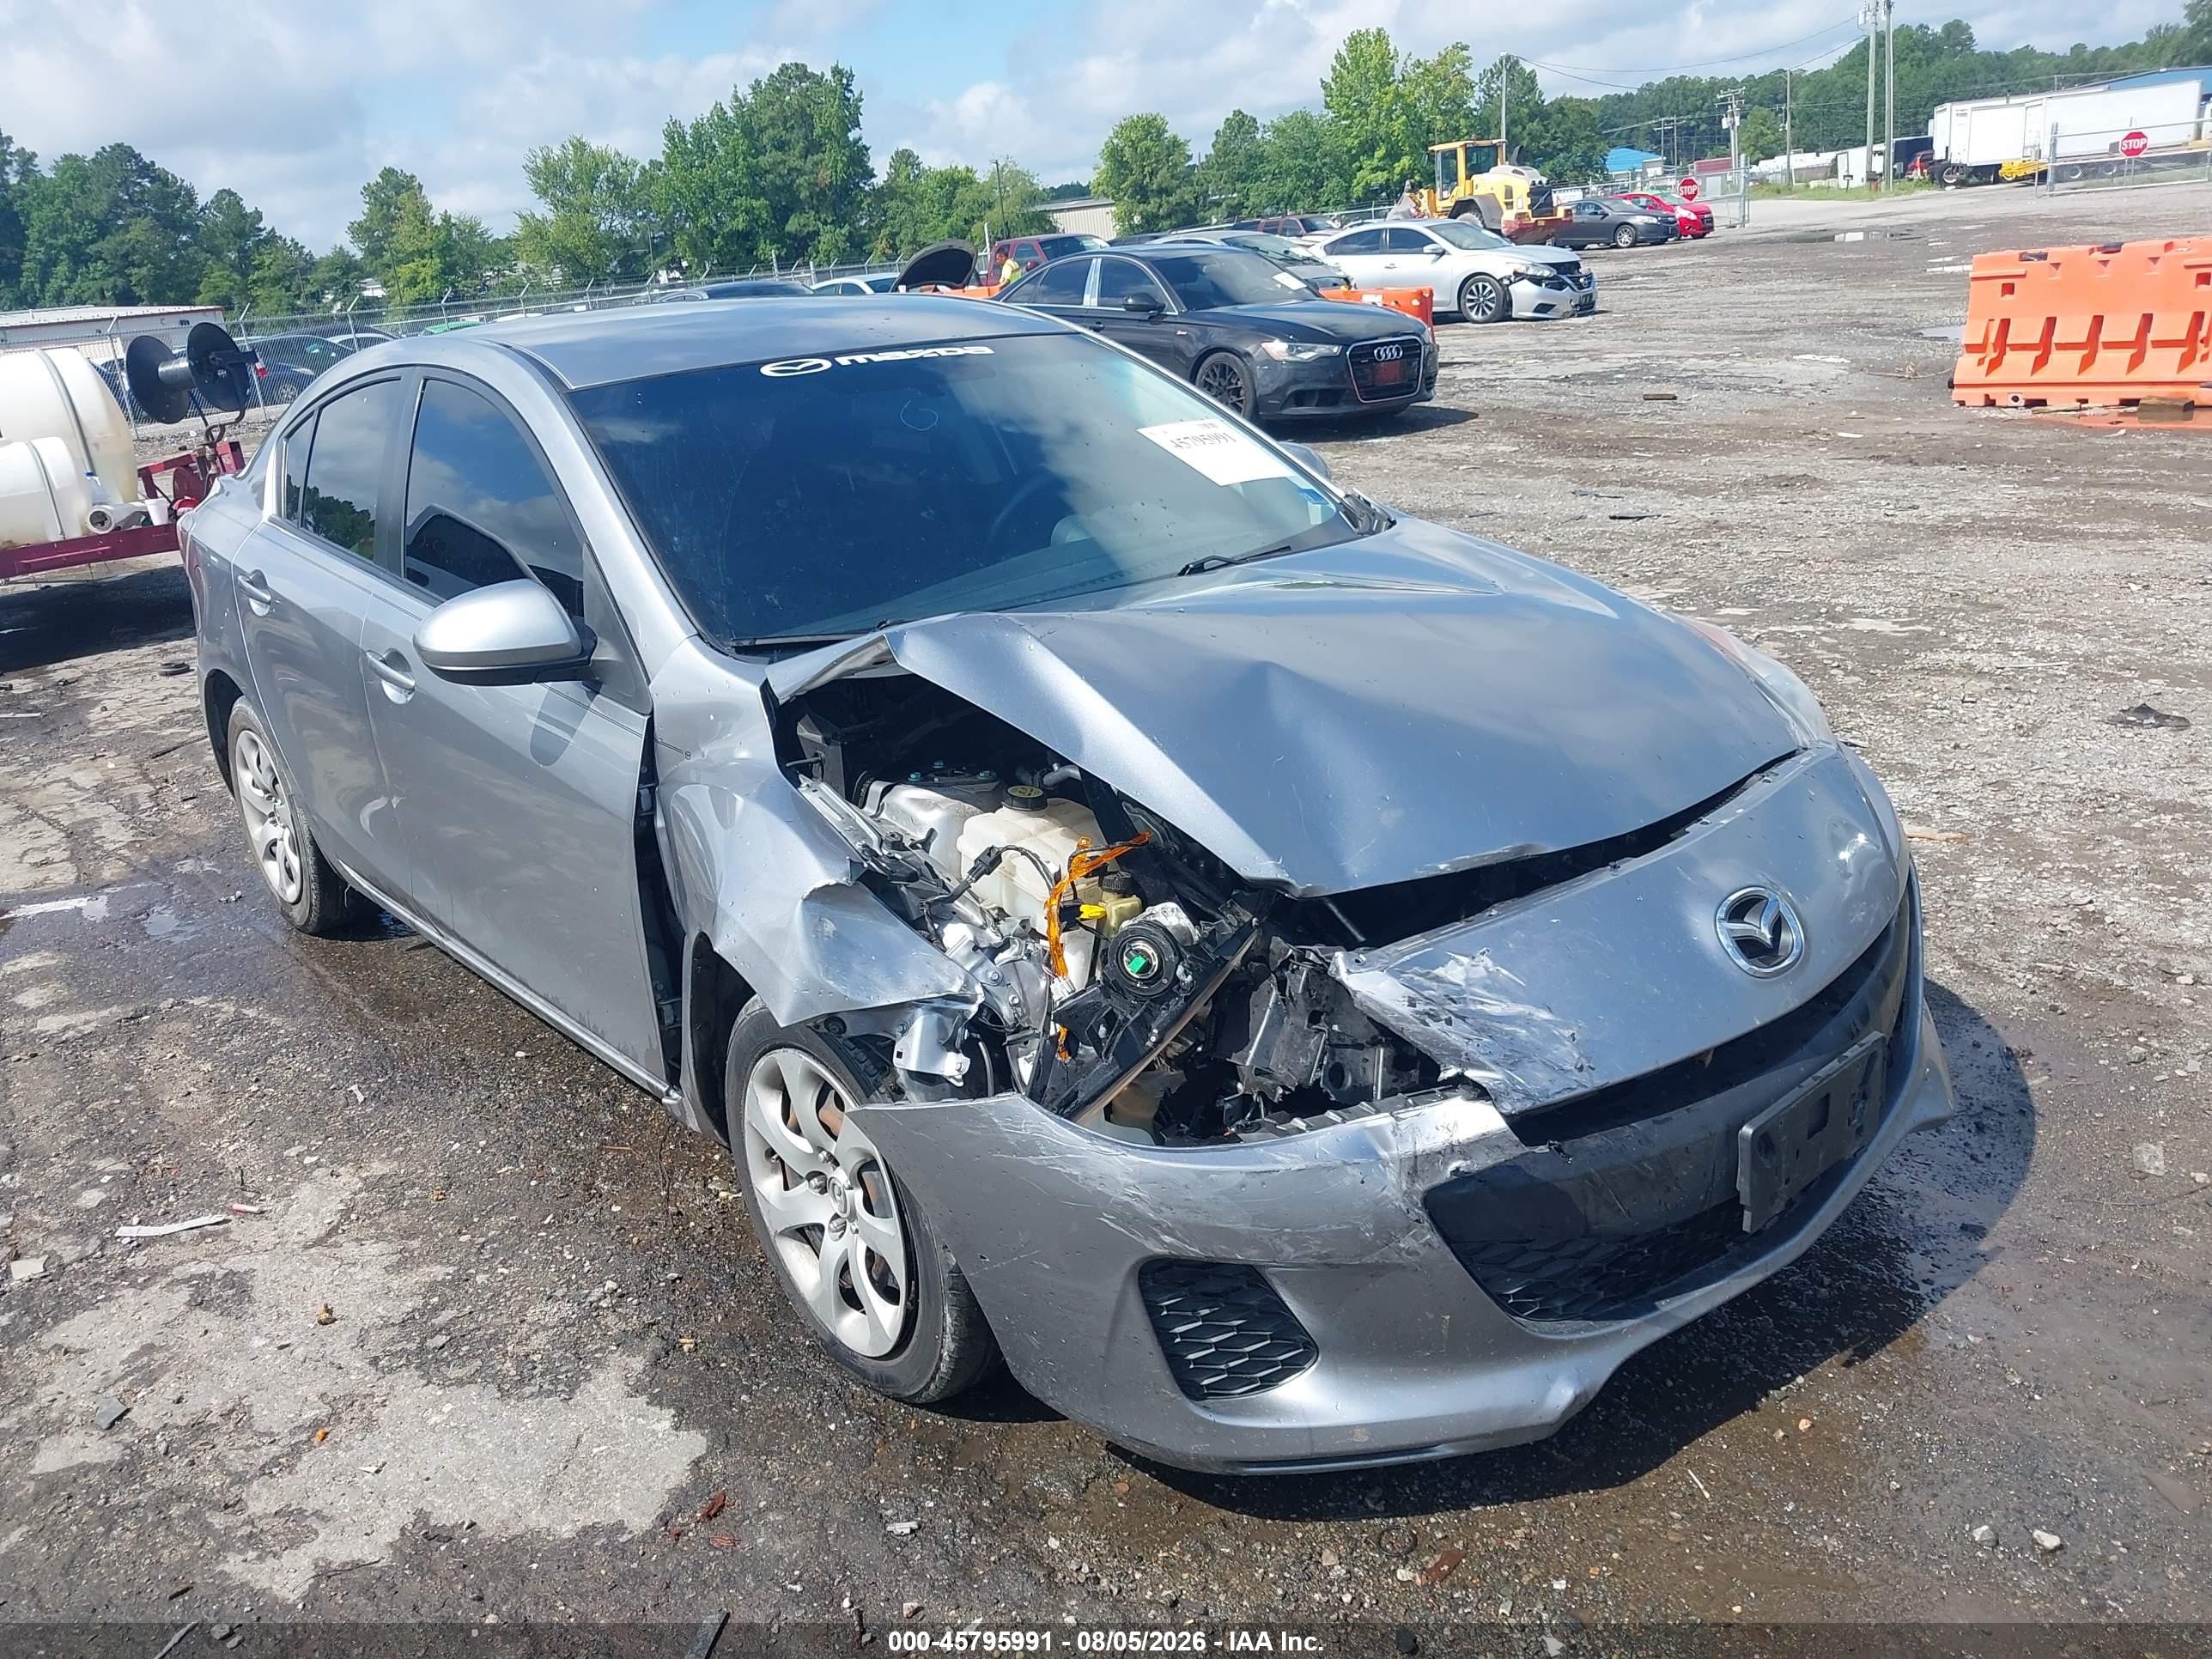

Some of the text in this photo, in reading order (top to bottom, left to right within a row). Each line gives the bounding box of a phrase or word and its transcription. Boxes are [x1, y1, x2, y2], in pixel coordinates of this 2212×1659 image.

[2121, 138, 2147, 151] STOP
[1679, 184, 1698, 196] STOP
[1170, 432, 1237, 449] 45795991
